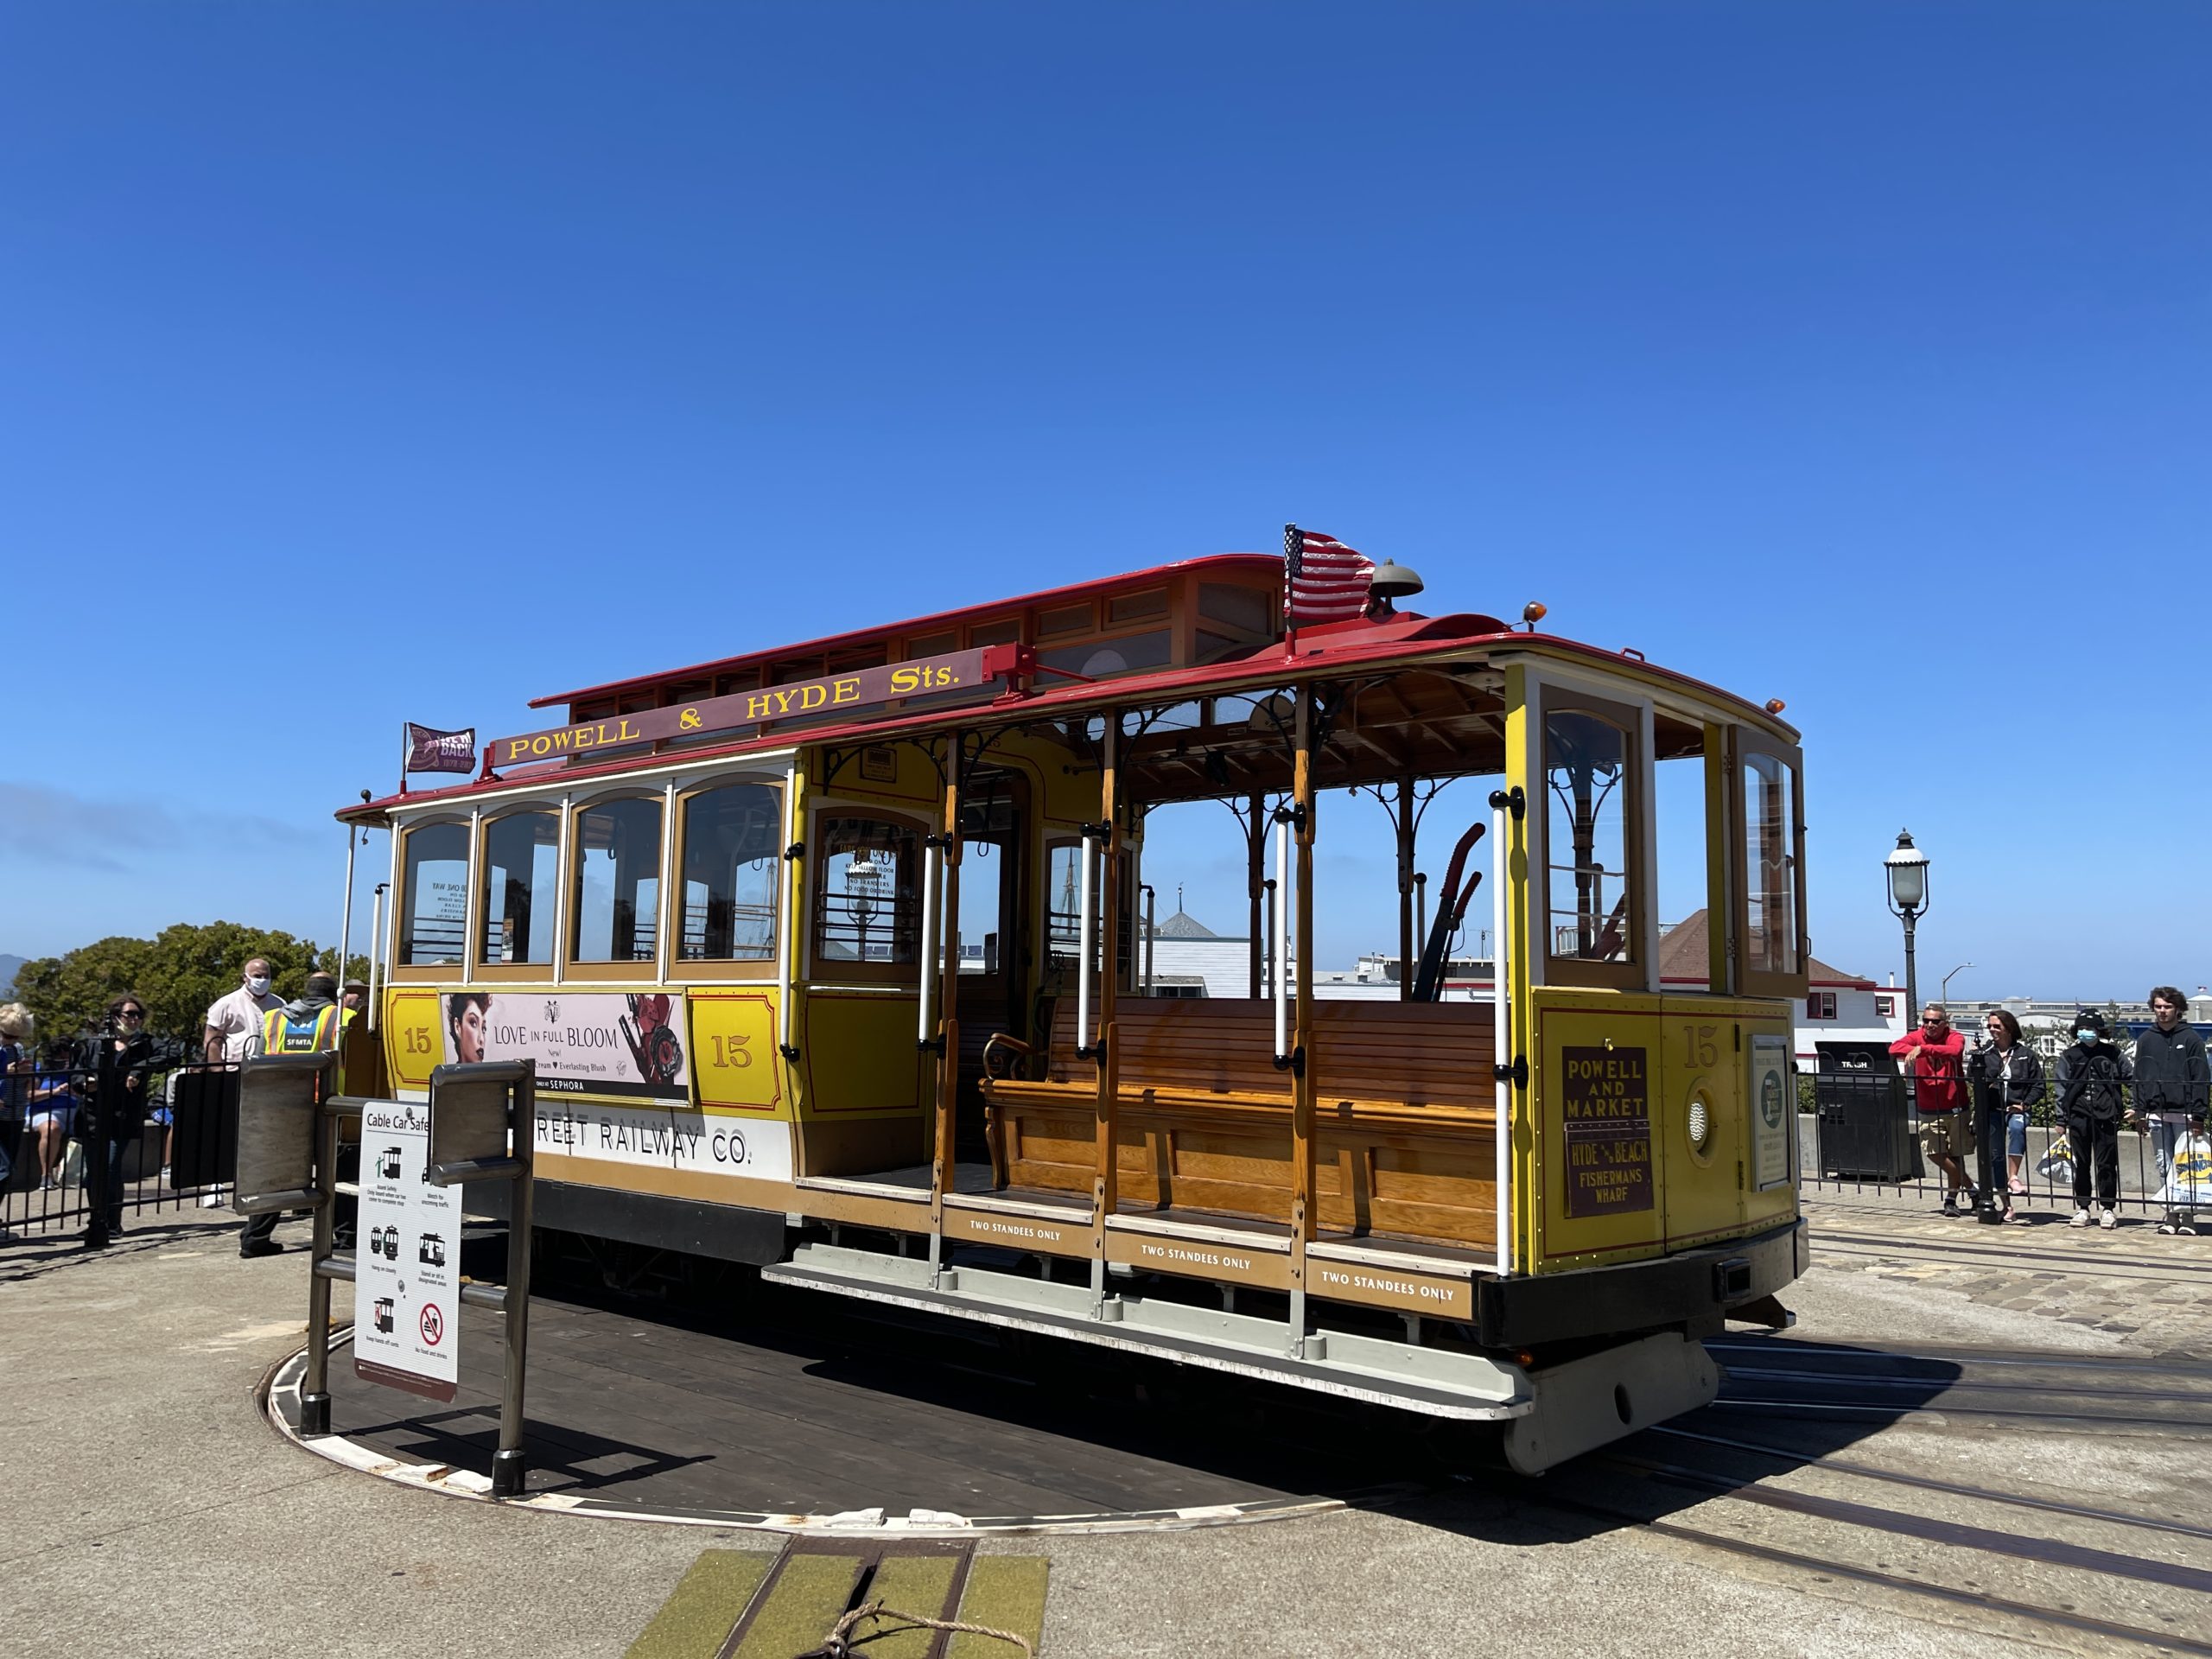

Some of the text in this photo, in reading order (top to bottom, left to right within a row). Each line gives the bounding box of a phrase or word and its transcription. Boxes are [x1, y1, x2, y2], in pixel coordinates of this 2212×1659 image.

[509, 664, 960, 760] POWELL & HYDE Sts.
[441, 742, 473, 757] BACK
[861, 879, 889, 887] TRANSERS
[404, 1027, 431, 1053] 15
[494, 1026, 618, 1049] LOVE IN FULL BLOOM
[1683, 1025, 1719, 1068] 15
[711, 1035, 752, 1067] 15
[559, 1062, 589, 1073] Everlasting
[591, 1063, 607, 1071] Blush
[1568, 1060, 1642, 1078] POWELL
[550, 1080, 584, 1090] SEPHORA
[1588, 1081, 1624, 1096] AND
[1567, 1097, 1643, 1117] MARKET
[367, 1113, 429, 1131] Cable Car Safe
[537, 1113, 751, 1165] REET RAILWAY CO.
[1572, 1142, 1599, 1166] HYDE
[1614, 1141, 1648, 1163] BEACH
[1579, 1168, 1643, 1188] FISHERMANS
[1595, 1186, 1628, 1204] WHARF
[970, 1220, 1060, 1241] TWO STANDEES ONLY
[1141, 1245, 1250, 1269] TWO STANDEES ONLY
[1322, 1271, 1453, 1300] TWO STANDEES ONLY
